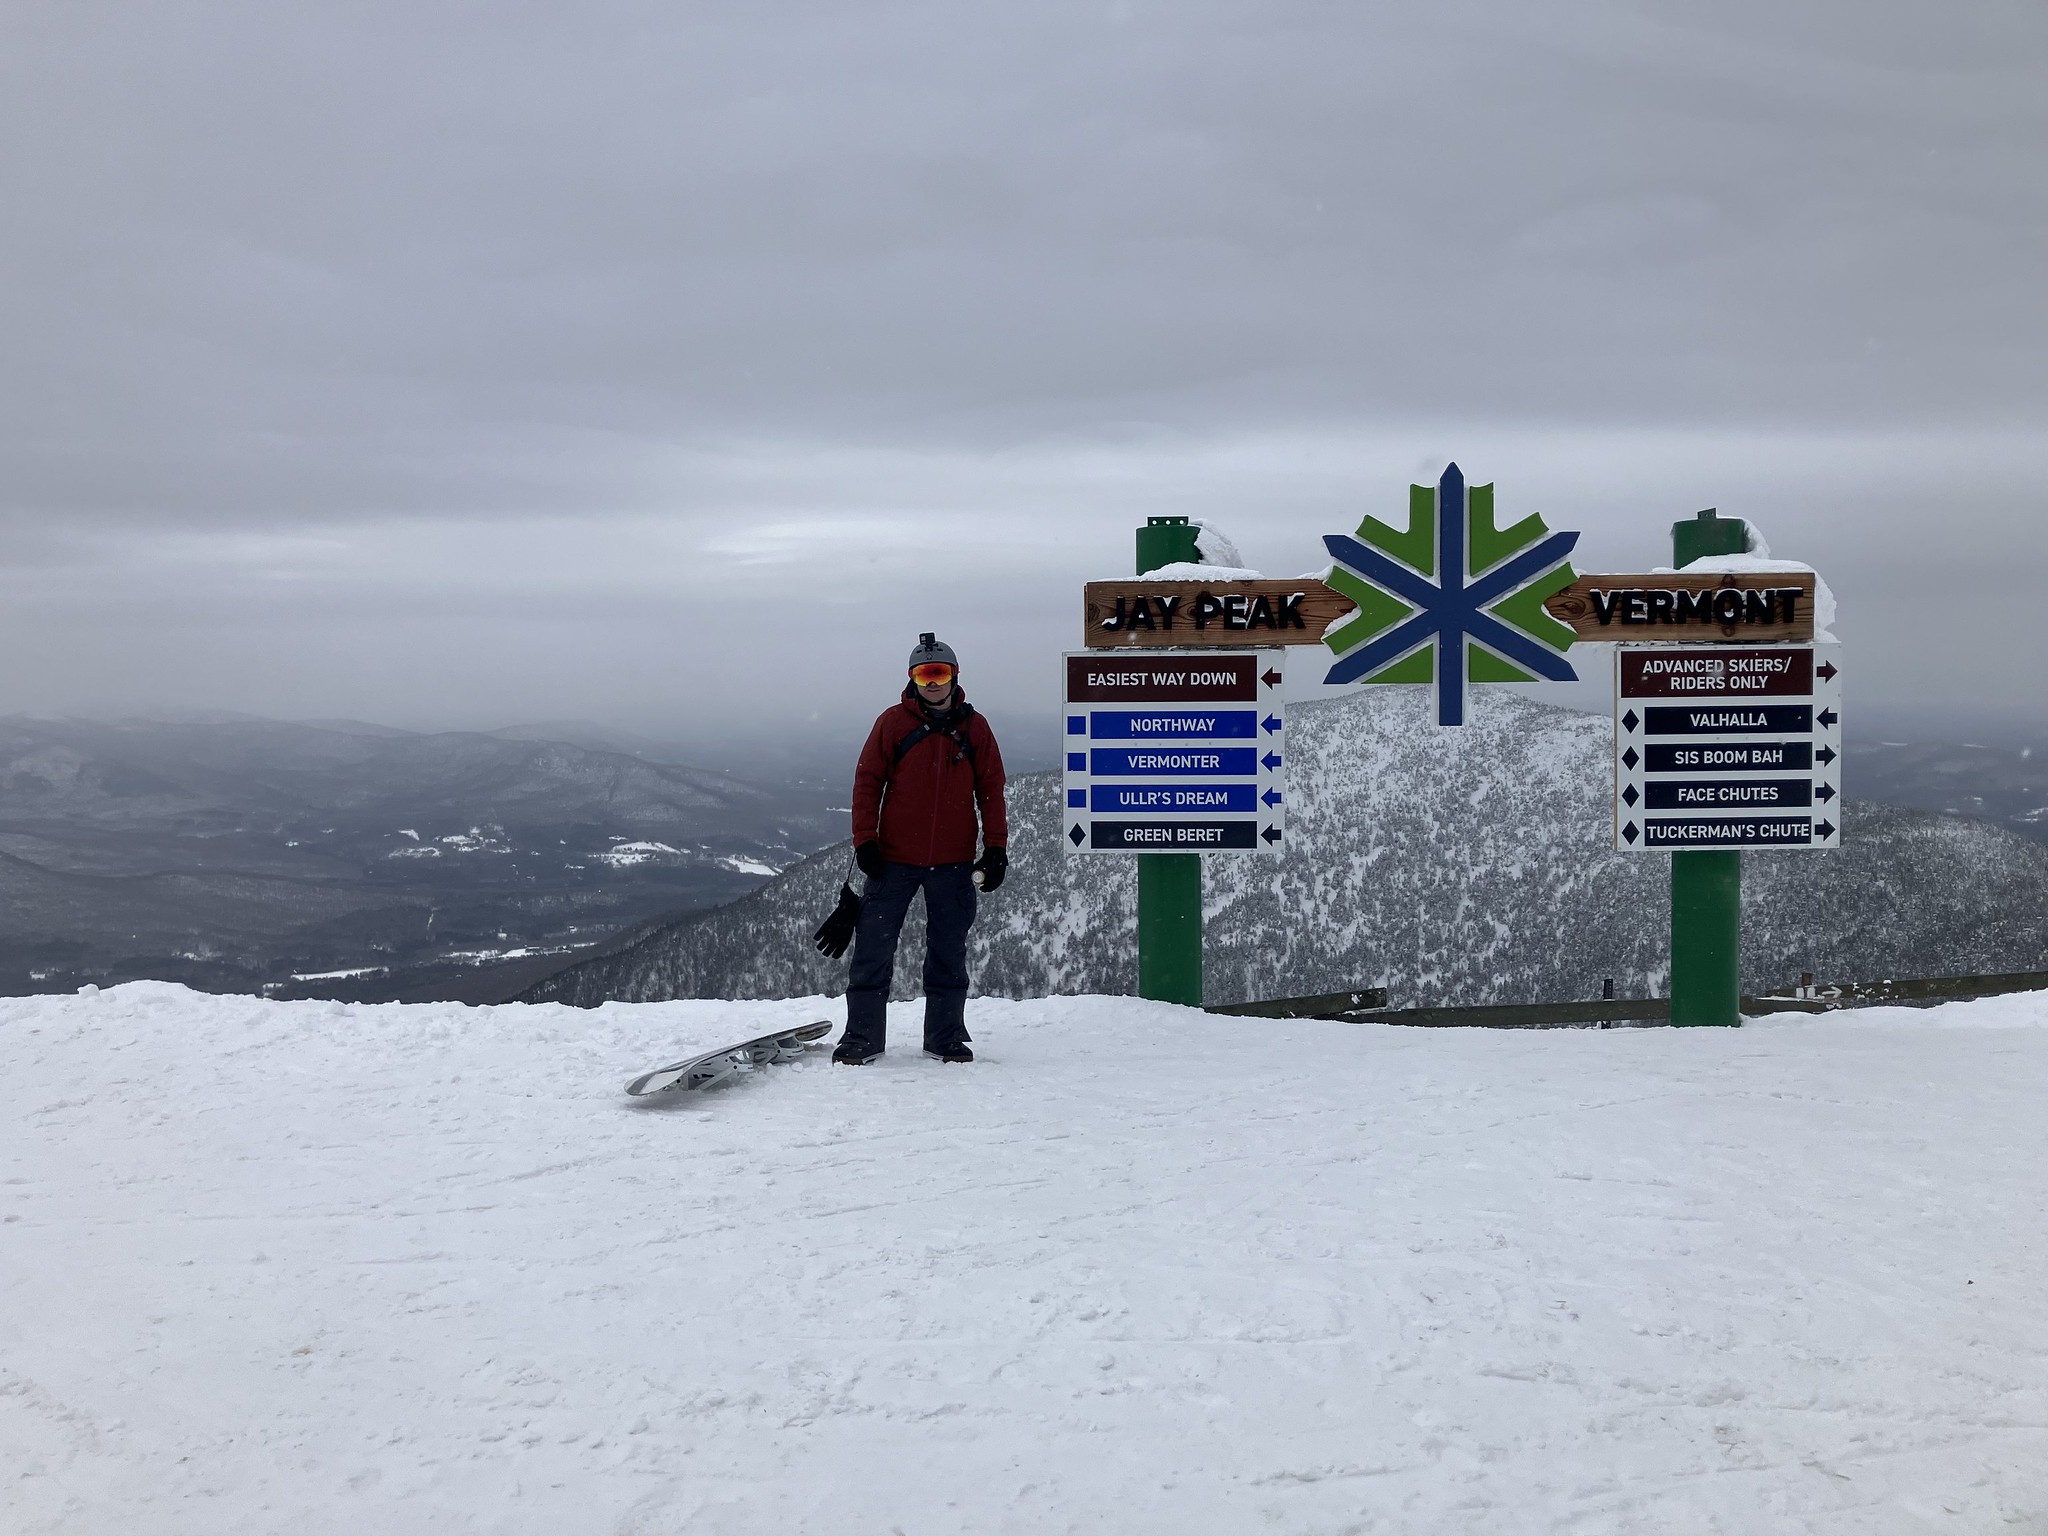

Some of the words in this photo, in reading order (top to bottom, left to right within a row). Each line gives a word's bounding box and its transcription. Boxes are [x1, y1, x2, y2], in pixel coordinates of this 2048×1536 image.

[1101, 595, 1182, 631] JAY
[1195, 593, 1306, 630] PEAK
[1590, 588, 1804, 625] VERMONT
[1642, 659, 1725, 674] ADVANCED
[1728, 656, 1792, 673] SKIERS/
[1087, 672, 1148, 686] EASIEST
[1151, 672, 1186, 686] WAY
[1190, 672, 1237, 686] DOWN
[1670, 676, 1726, 690] RIDERS
[1729, 675, 1769, 689] ONLY
[1130, 718, 1216, 732] NORTHWAY
[1690, 712, 1768, 727] VALHALLA
[1127, 755, 1220, 769] VERMONTER
[1674, 751, 1699, 765] SIS
[1703, 750, 1748, 764] BOOM
[1752, 749, 1783, 764] BAH
[1119, 791, 1172, 806] ULLR'S
[1175, 791, 1229, 805] DREAM
[1677, 788, 1715, 801] FACE
[1719, 786, 1779, 800] CHUTES
[1123, 828, 1172, 842] GREEN
[1177, 828, 1224, 842] BERET
[1646, 824, 1756, 839] TUCKERMAN'S
[1759, 823, 1810, 838] CHUTE
